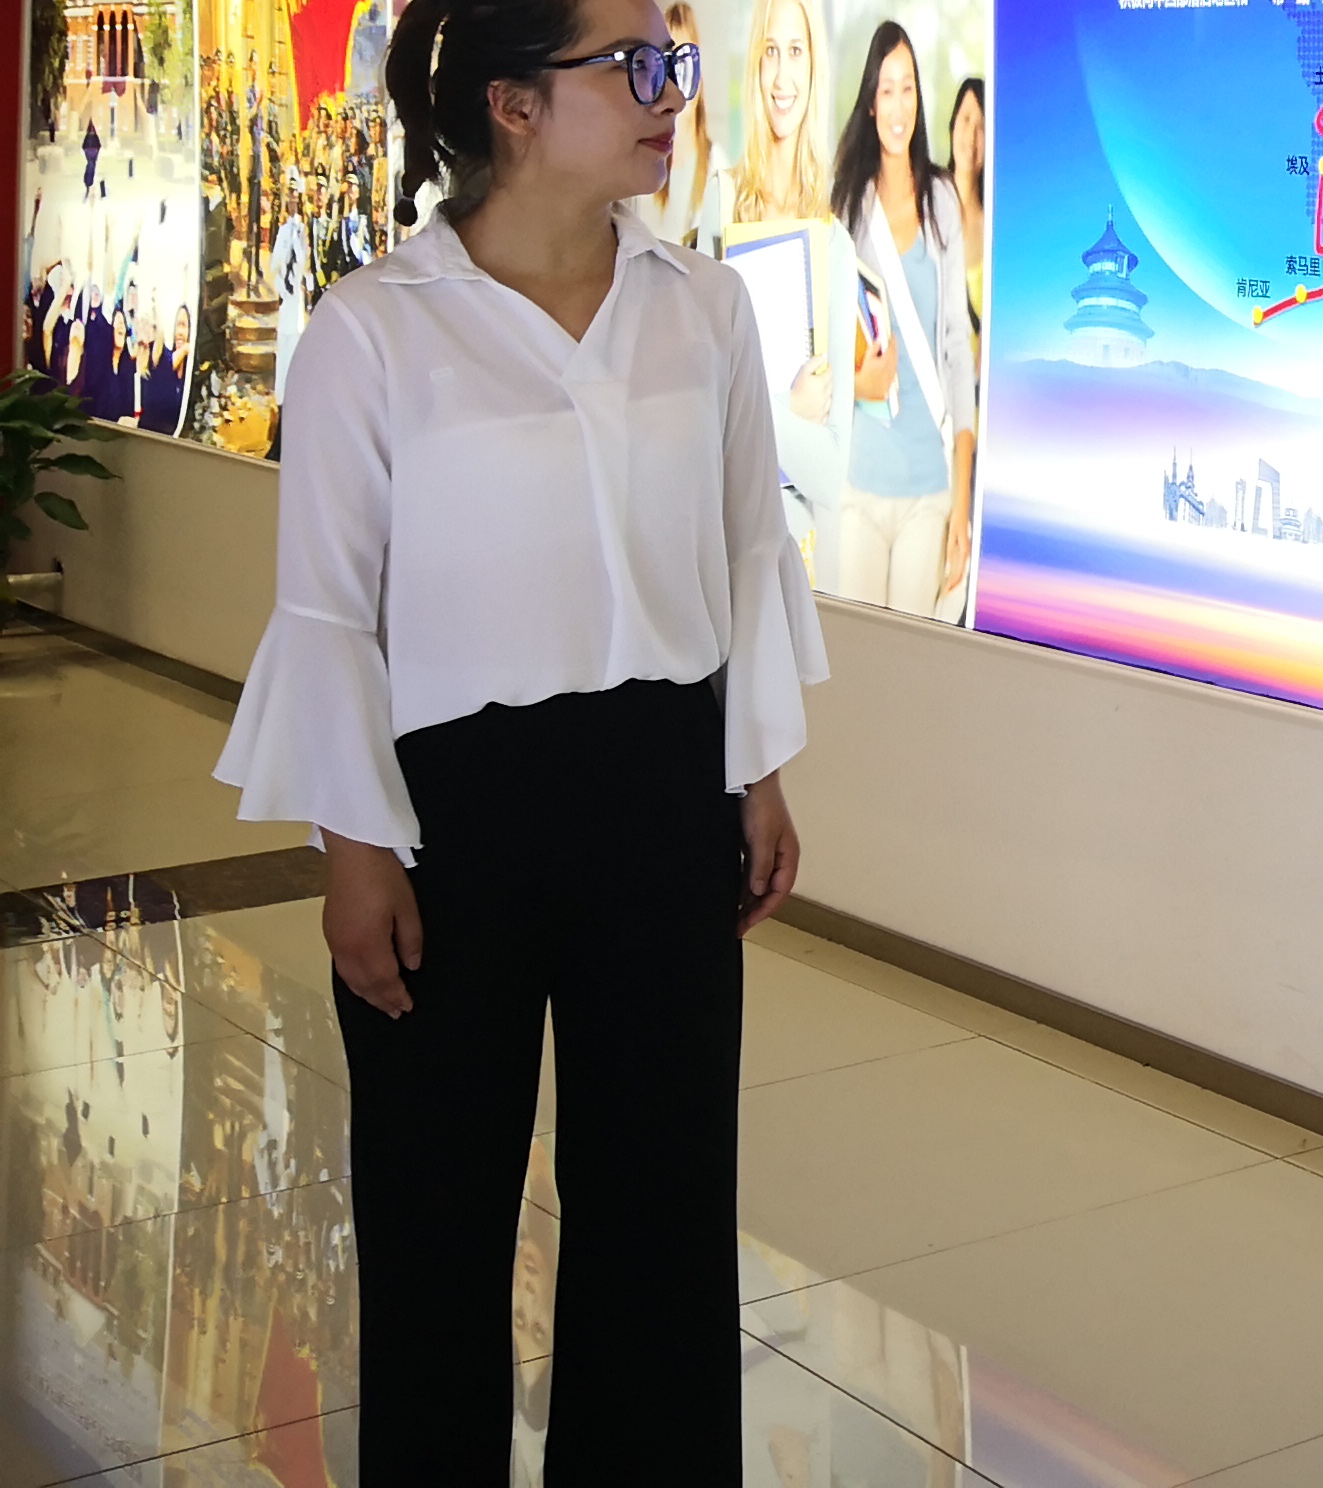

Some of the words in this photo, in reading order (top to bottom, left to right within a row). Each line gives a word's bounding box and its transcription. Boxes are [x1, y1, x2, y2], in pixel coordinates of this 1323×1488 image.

[1286, 155, 1309, 176] 埃及
[1285, 255, 1321, 276] 索马里
[1236, 278, 1271, 299] 肯尼亚
